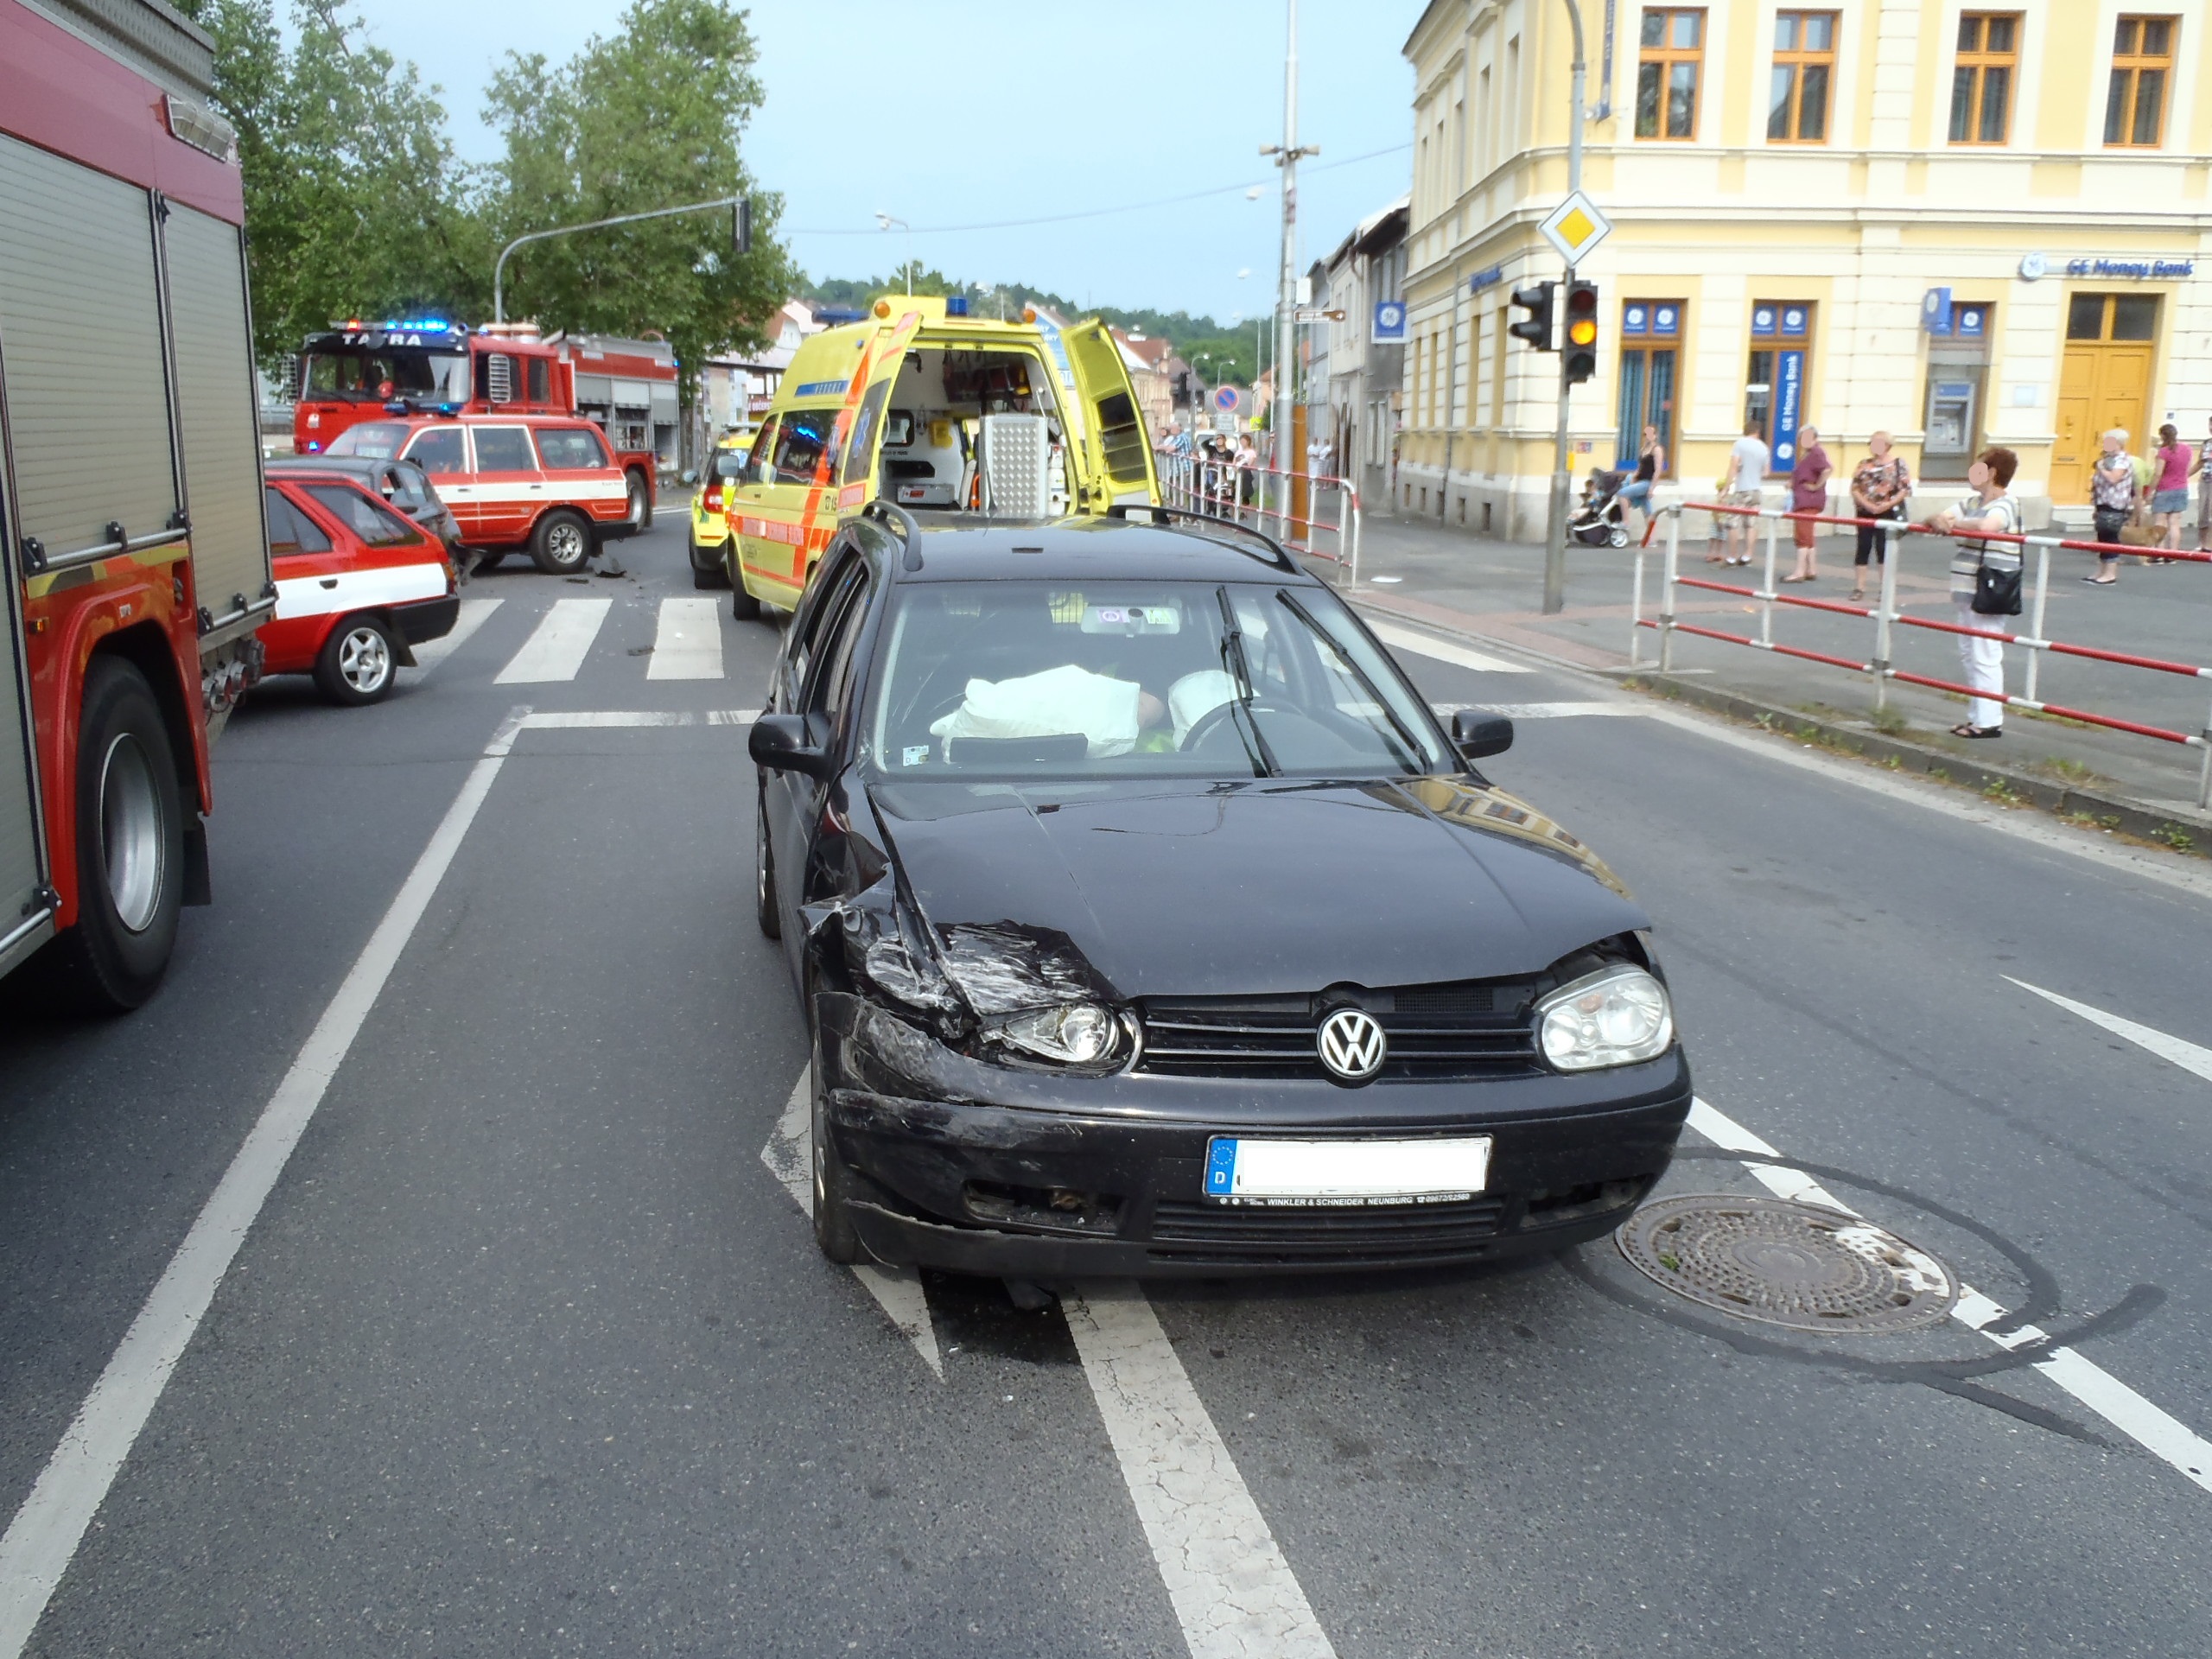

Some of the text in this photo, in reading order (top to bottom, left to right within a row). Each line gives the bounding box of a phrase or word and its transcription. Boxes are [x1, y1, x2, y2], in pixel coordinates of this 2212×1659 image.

[2067, 259, 2194, 277] GE Money Bank
[342, 333, 422, 346] TARA
[1786, 354, 1798, 381] Bank
[1783, 381, 1799, 416] Money
[1214, 1171, 1227, 1185] D
[1267, 1198, 1306, 1206] WINKLER
[1307, 1198, 1314, 1206] &
[1315, 1197, 1364, 1206] SCHNEIDER
[1367, 1197, 1414, 1206] NEUNBURG
